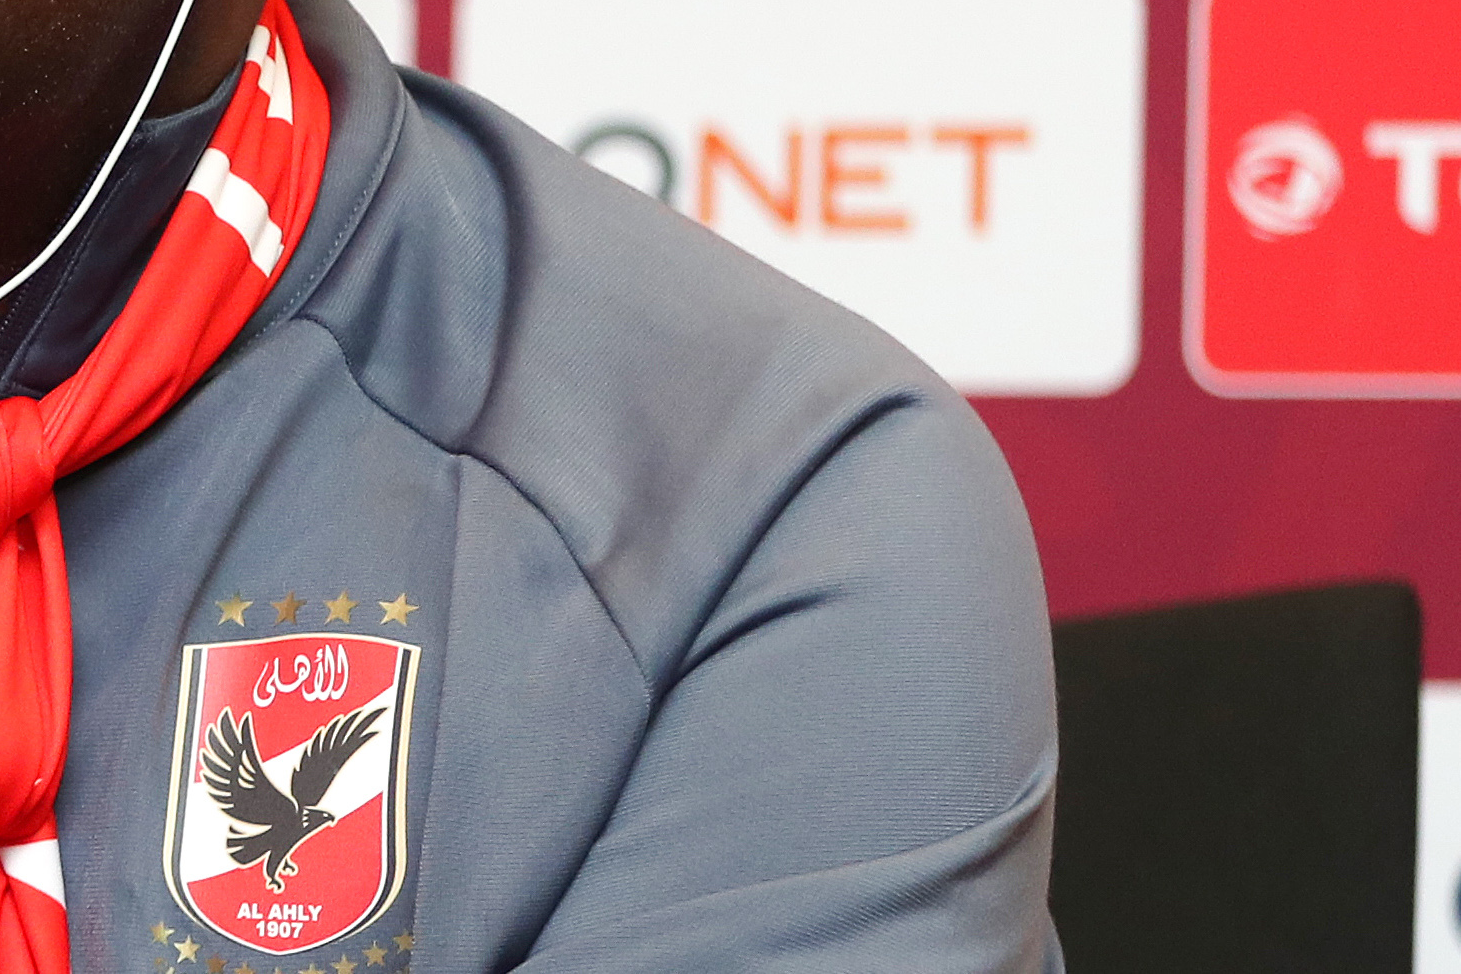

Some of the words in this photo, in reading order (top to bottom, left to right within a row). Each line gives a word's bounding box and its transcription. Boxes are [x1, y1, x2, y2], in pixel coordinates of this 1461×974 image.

[236, 902, 264, 920] AL
[267, 903, 323, 922] AHLY
[255, 920, 304, 938] 1907
